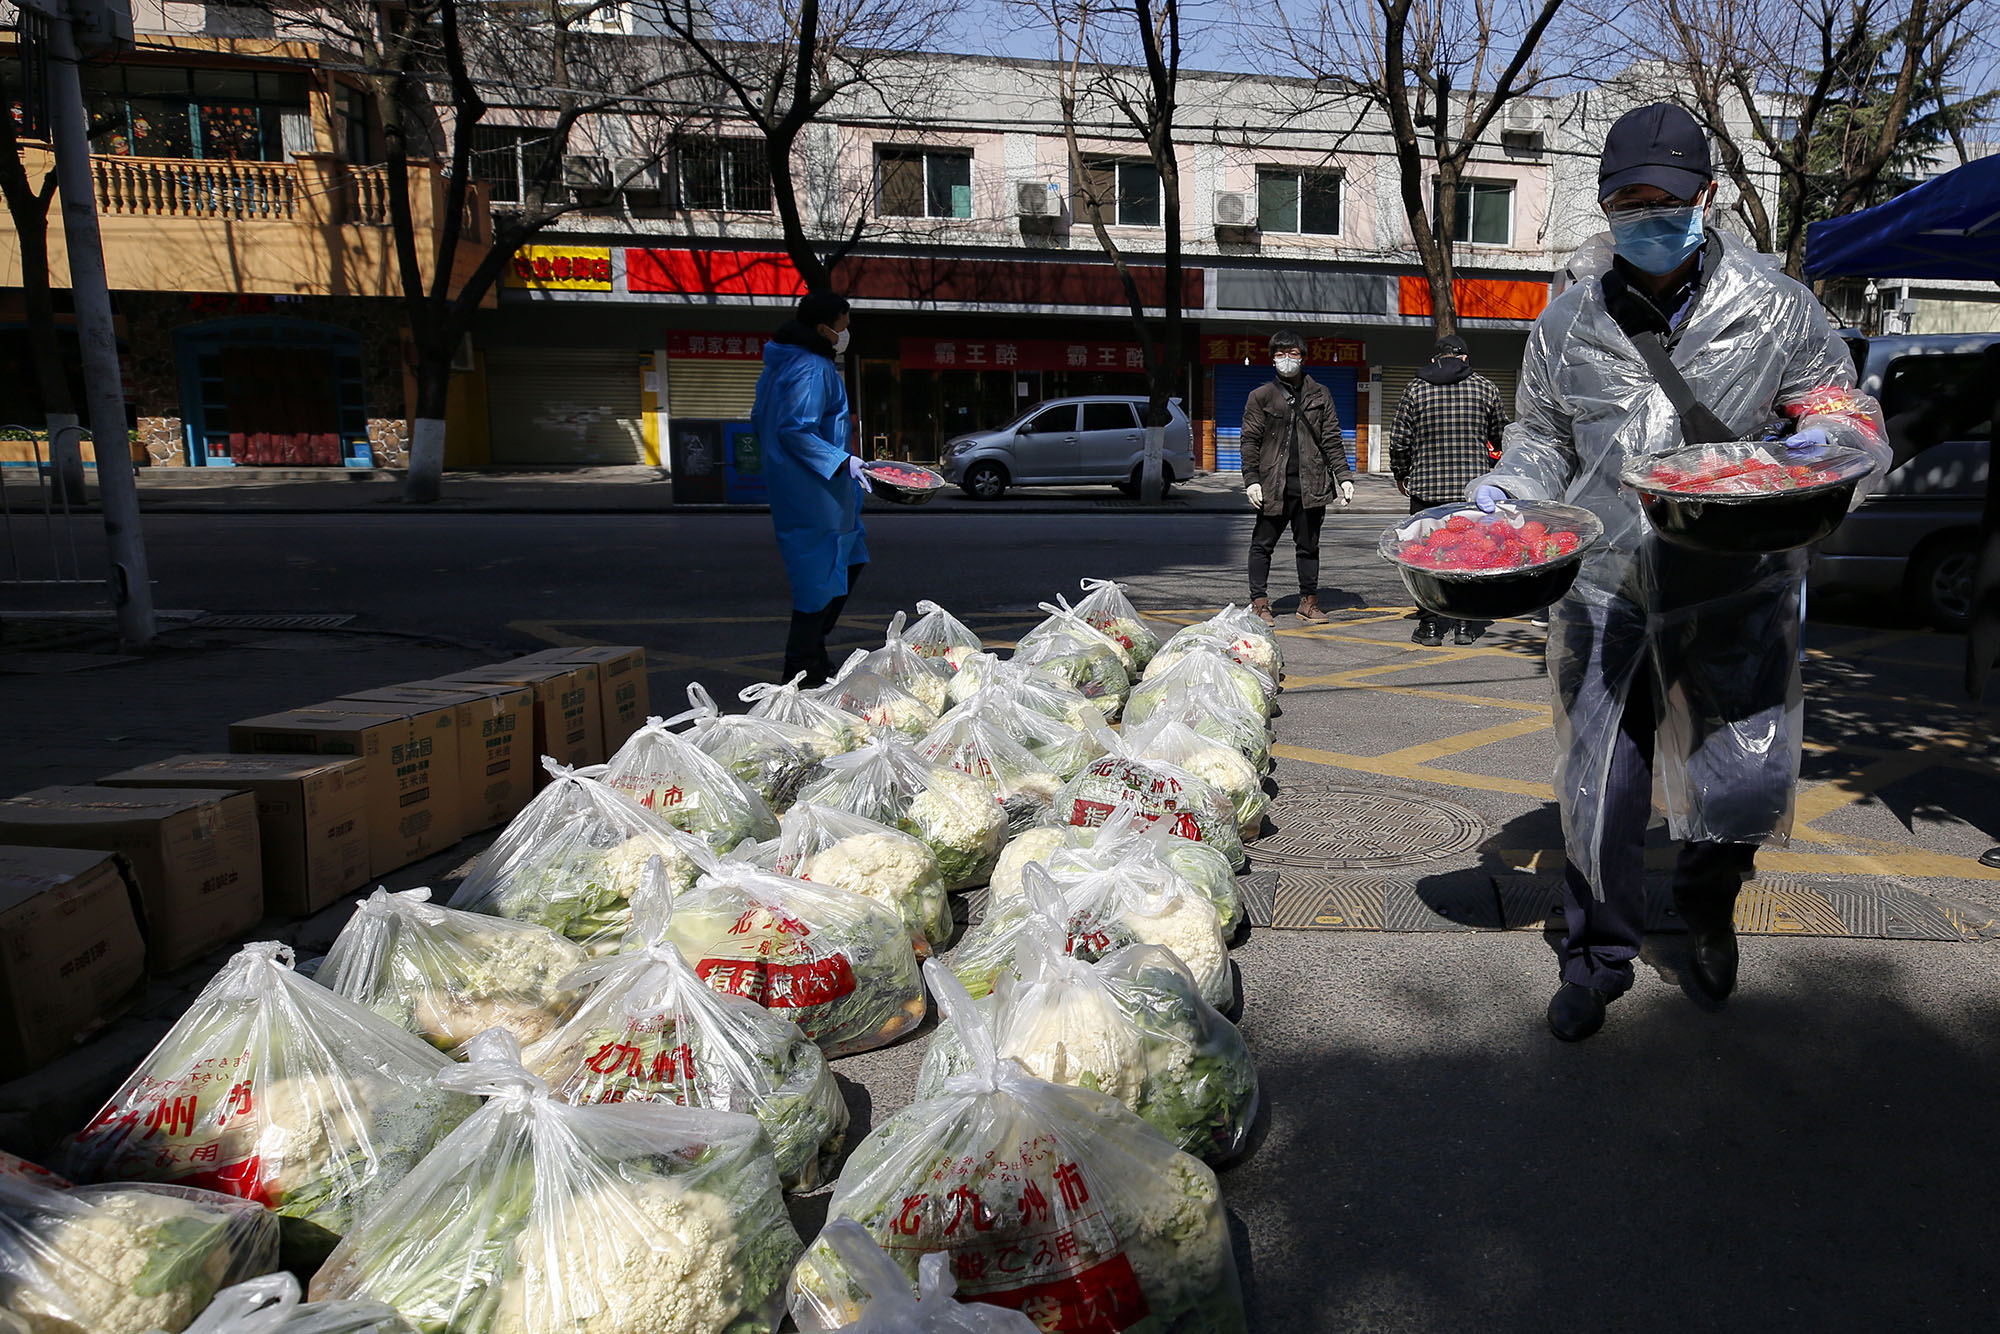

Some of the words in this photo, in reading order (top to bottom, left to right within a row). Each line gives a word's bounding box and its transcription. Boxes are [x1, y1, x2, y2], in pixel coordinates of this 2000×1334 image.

[688, 335, 774, 355] 郭家堂鼻
[934, 342, 1018, 366] 霸王醉
